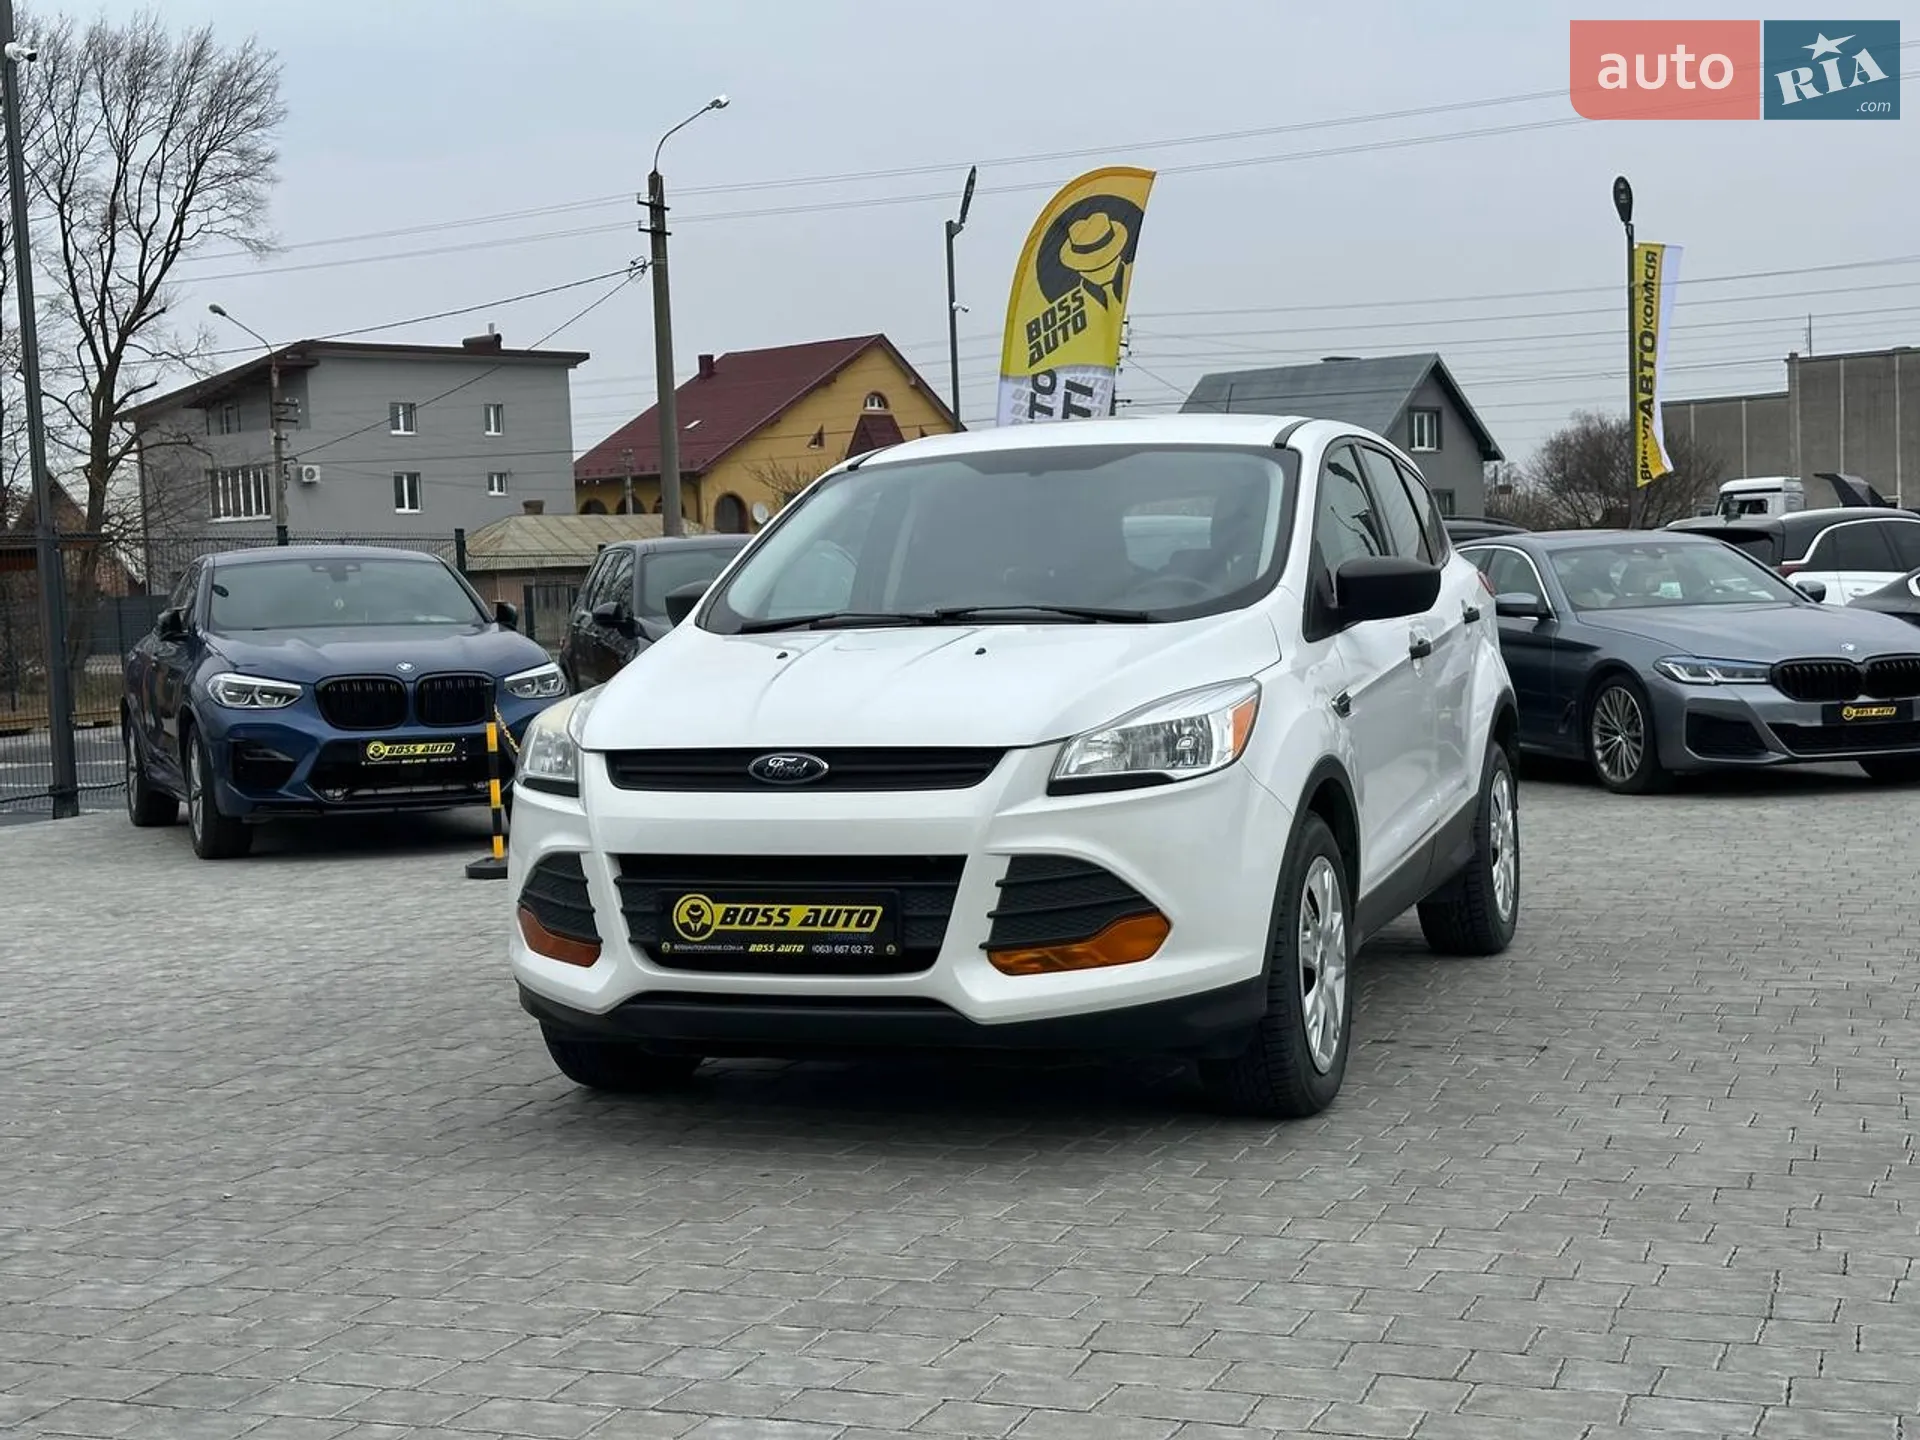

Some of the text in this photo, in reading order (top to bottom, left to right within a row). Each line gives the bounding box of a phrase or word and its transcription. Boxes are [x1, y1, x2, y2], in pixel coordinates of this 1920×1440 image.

[1026, 288, 1085, 344] BOSS
[1028, 308, 1087, 368] AUTO
[1639, 330, 1656, 419] АВТО
[1028, 368, 1057, 420] ТО
[387, 744, 452, 754] BOSS AUTO
[718, 907, 878, 928] BOSS AUTO
[748, 944, 804, 952] BOSS AUTO
[863, 944, 875, 953] 72
